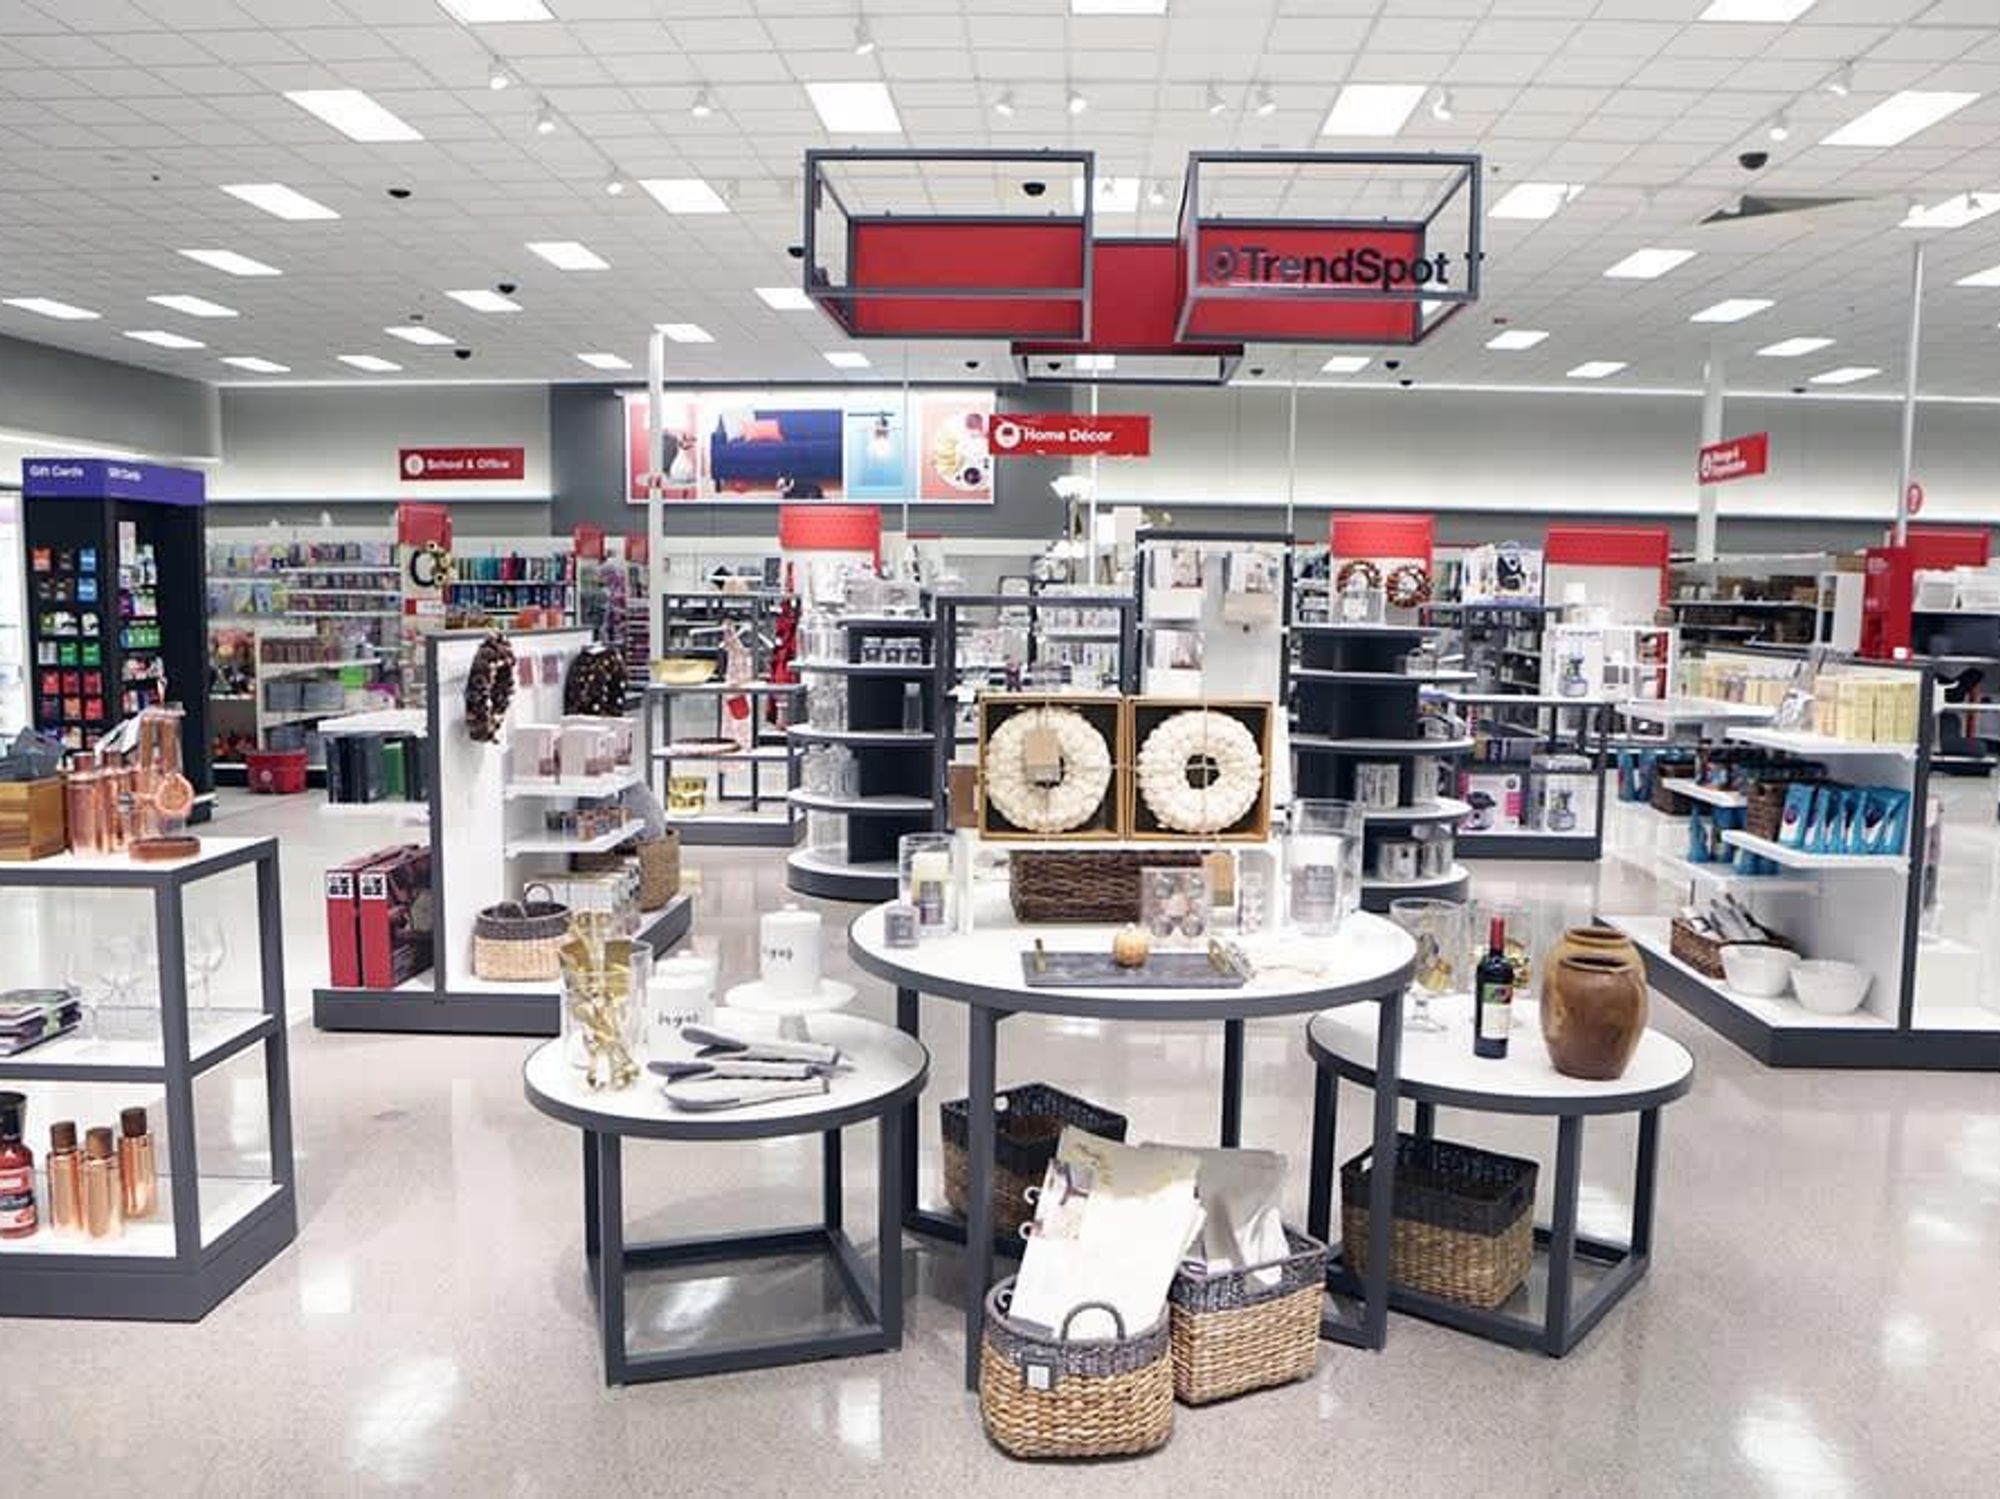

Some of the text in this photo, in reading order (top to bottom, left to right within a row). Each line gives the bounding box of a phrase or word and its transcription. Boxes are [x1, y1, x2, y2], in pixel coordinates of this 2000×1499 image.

[1240, 246, 1449, 292] TrendSpot
[1024, 427, 1114, 442] Home Décor
